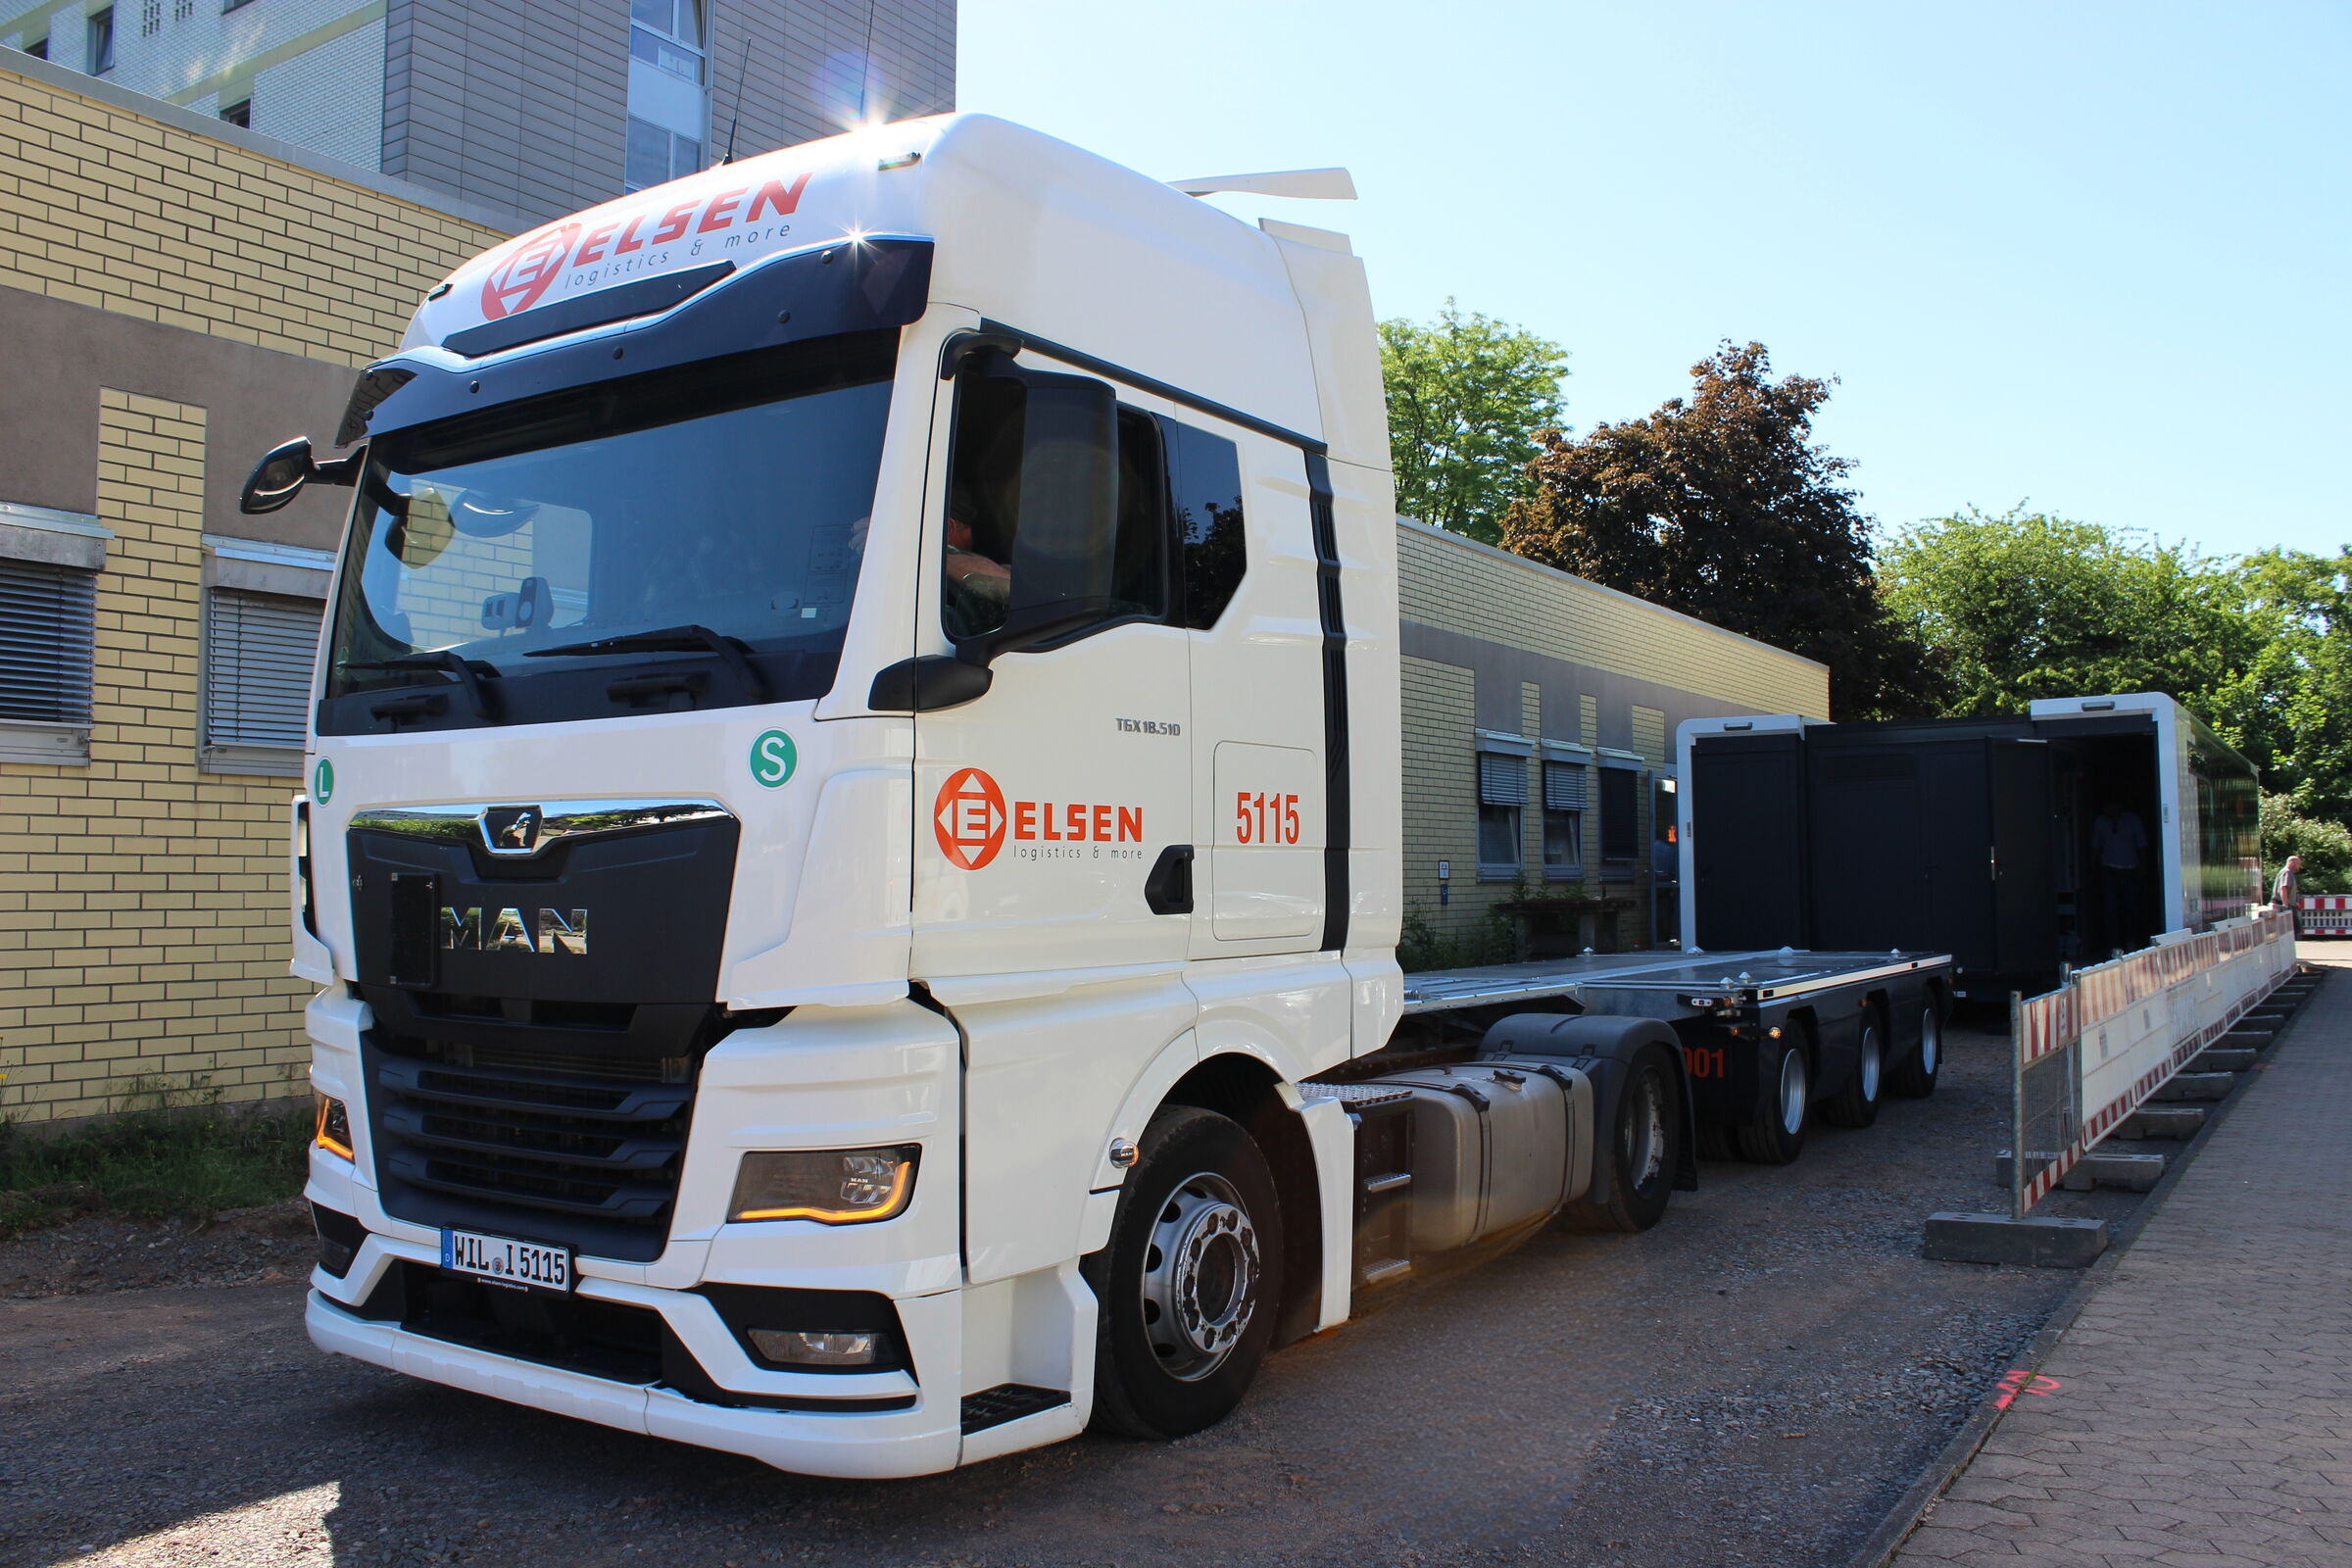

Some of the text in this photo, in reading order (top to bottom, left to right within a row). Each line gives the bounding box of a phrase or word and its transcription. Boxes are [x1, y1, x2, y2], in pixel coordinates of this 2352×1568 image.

[572, 172, 814, 268] ELSEN
[564, 221, 793, 291] logistics & more
[760, 736, 787, 782] S
[1013, 801, 1144, 843] ELSEN
[1236, 792, 1300, 845] 5115
[1013, 844, 1144, 862] logistics & more
[440, 906, 589, 956] MAN
[444, 1234, 566, 1286] D WIL I 5115
